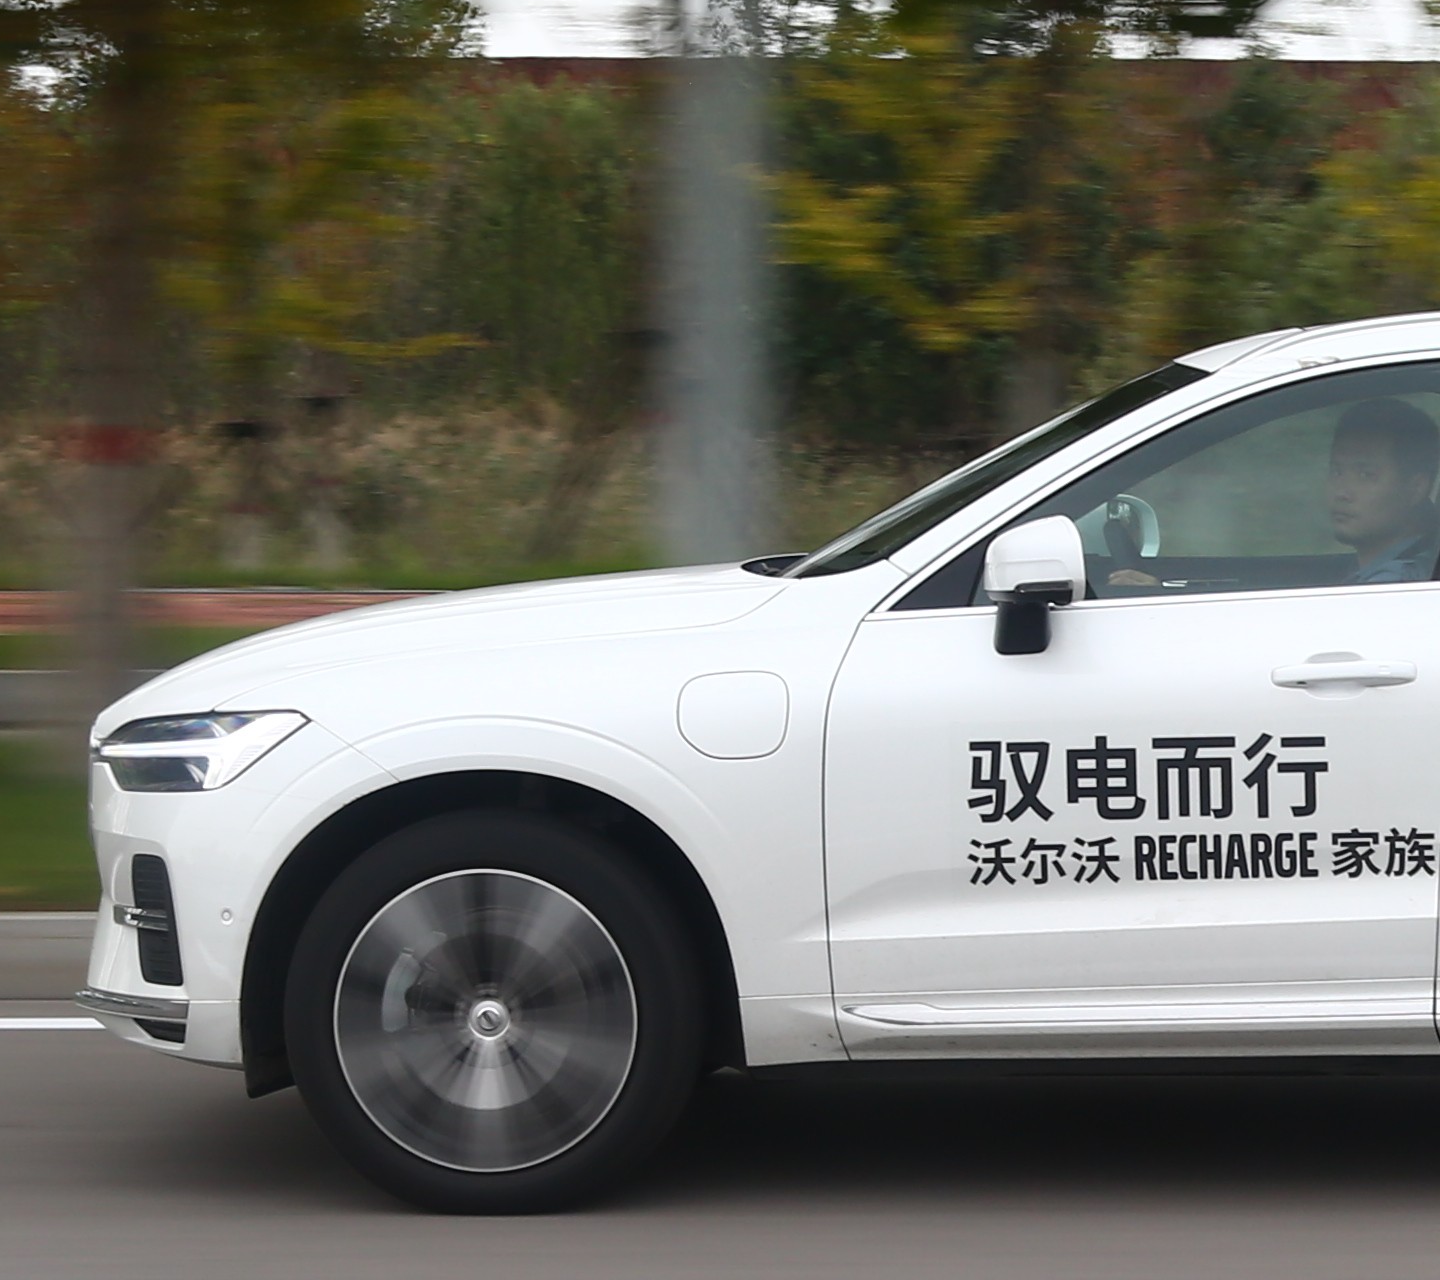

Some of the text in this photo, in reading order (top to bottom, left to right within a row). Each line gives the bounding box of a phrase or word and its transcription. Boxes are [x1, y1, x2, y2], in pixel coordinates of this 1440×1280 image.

[967, 734, 1328, 823] 驭电而行
[967, 837, 1120, 886] 沃尔沃
[1134, 832, 1319, 881] RECHARGE
